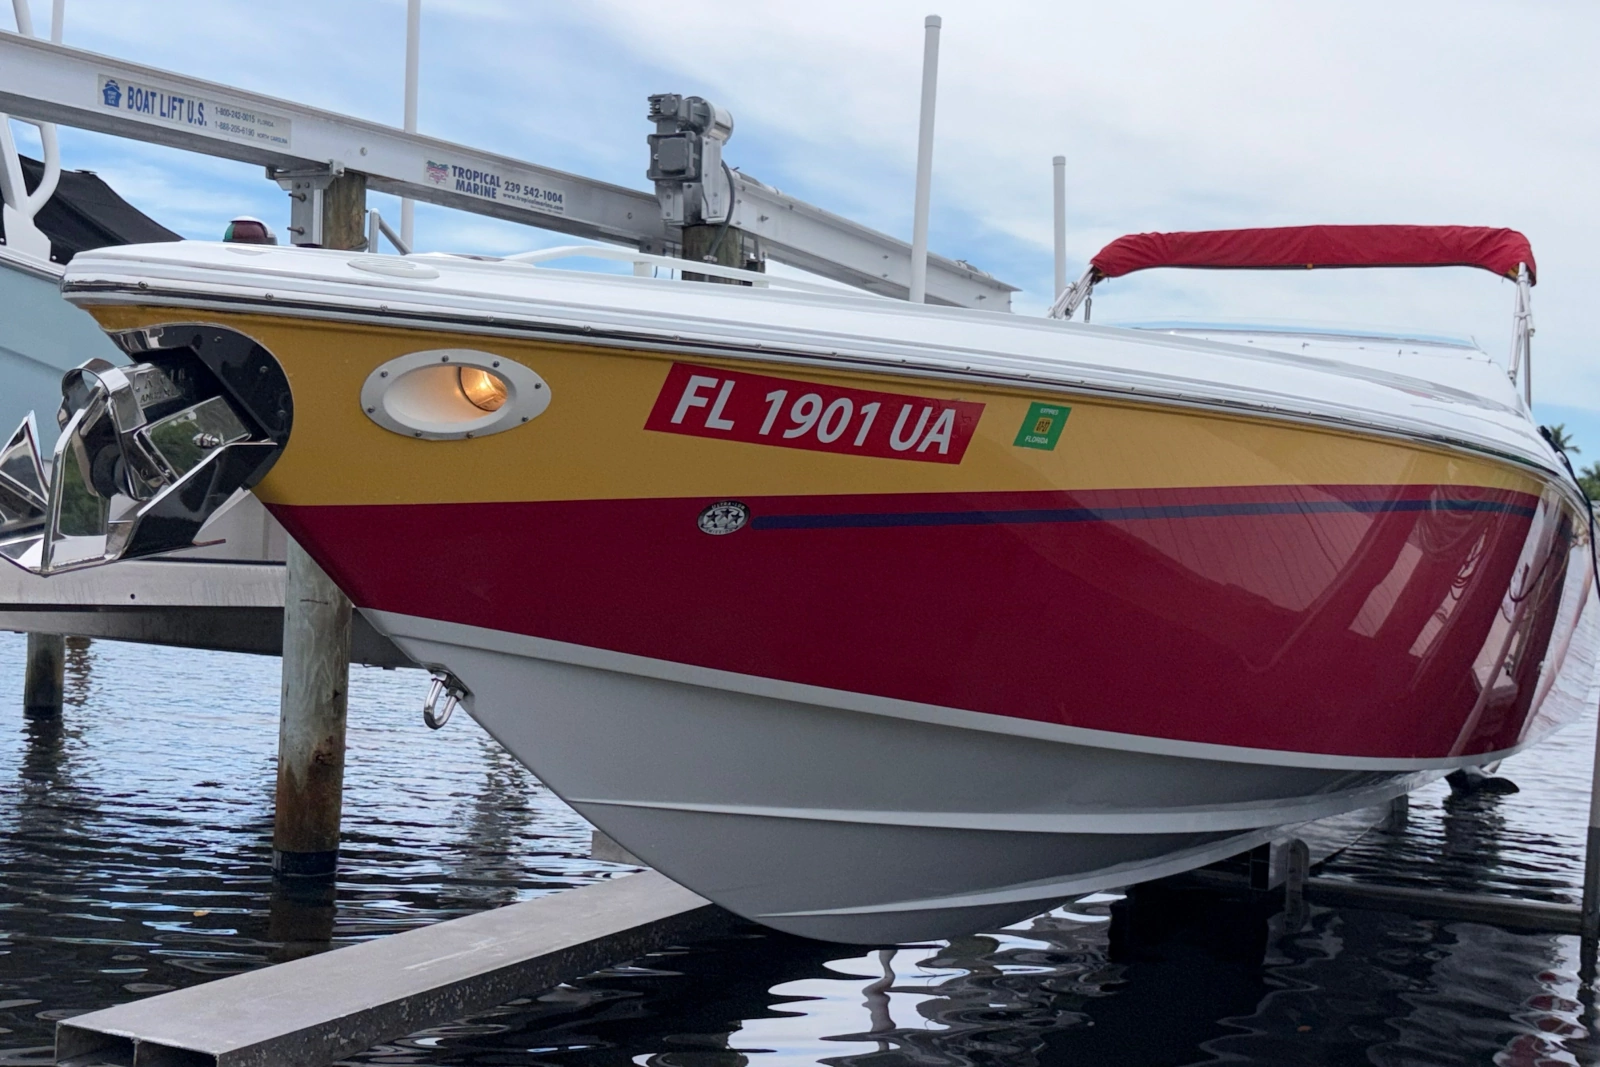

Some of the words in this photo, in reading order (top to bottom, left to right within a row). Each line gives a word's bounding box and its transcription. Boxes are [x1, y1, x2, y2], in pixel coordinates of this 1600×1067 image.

[128, 86, 157, 115] BOAT
[160, 94, 185, 121] LIFT
[187, 100, 207, 127] U.S.
[452, 165, 501, 188] TROPICAL
[455, 179, 497, 199] MARINE
[504, 180, 521, 194] 239
[523, 185, 563, 204] 542-1004
[670, 375, 736, 431] FL
[758, 389, 881, 447] 1901
[889, 404, 956, 455] UA
[1025, 435, 1048, 444] FLORIDA
